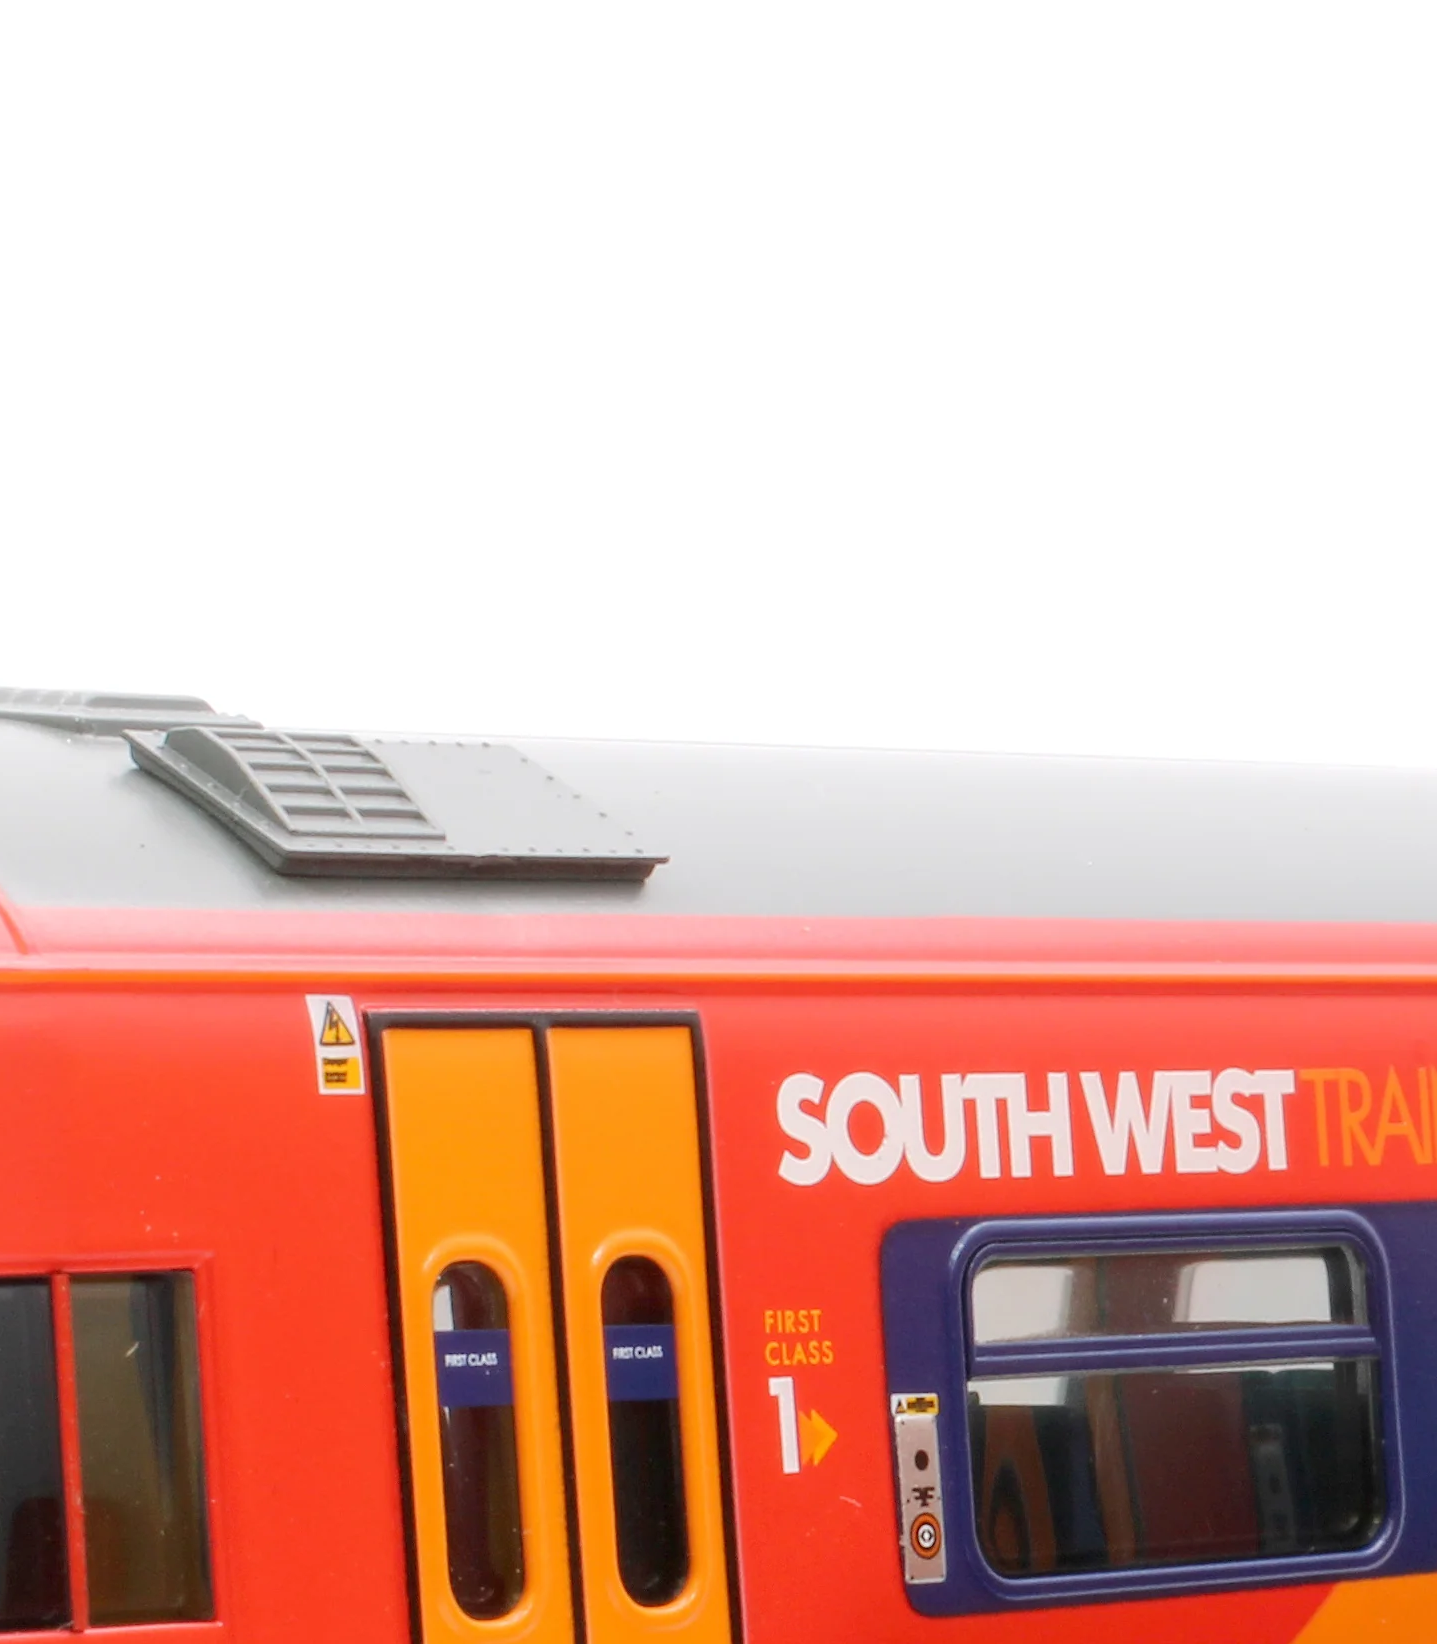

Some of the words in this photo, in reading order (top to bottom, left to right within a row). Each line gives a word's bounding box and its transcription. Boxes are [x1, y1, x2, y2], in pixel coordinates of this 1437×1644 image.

[777, 1072, 1074, 1186] SOUTH
[1080, 1067, 1296, 1176] WEST
[764, 1309, 822, 1333] FIRST
[445, 1353, 467, 1367] FIRST
[468, 1352, 498, 1366] CLASS
[612, 1347, 633, 1360] FIRST
[634, 1345, 663, 1358] CLASS
[765, 1341, 834, 1366] CLASS
[768, 1376, 800, 1474] 1
